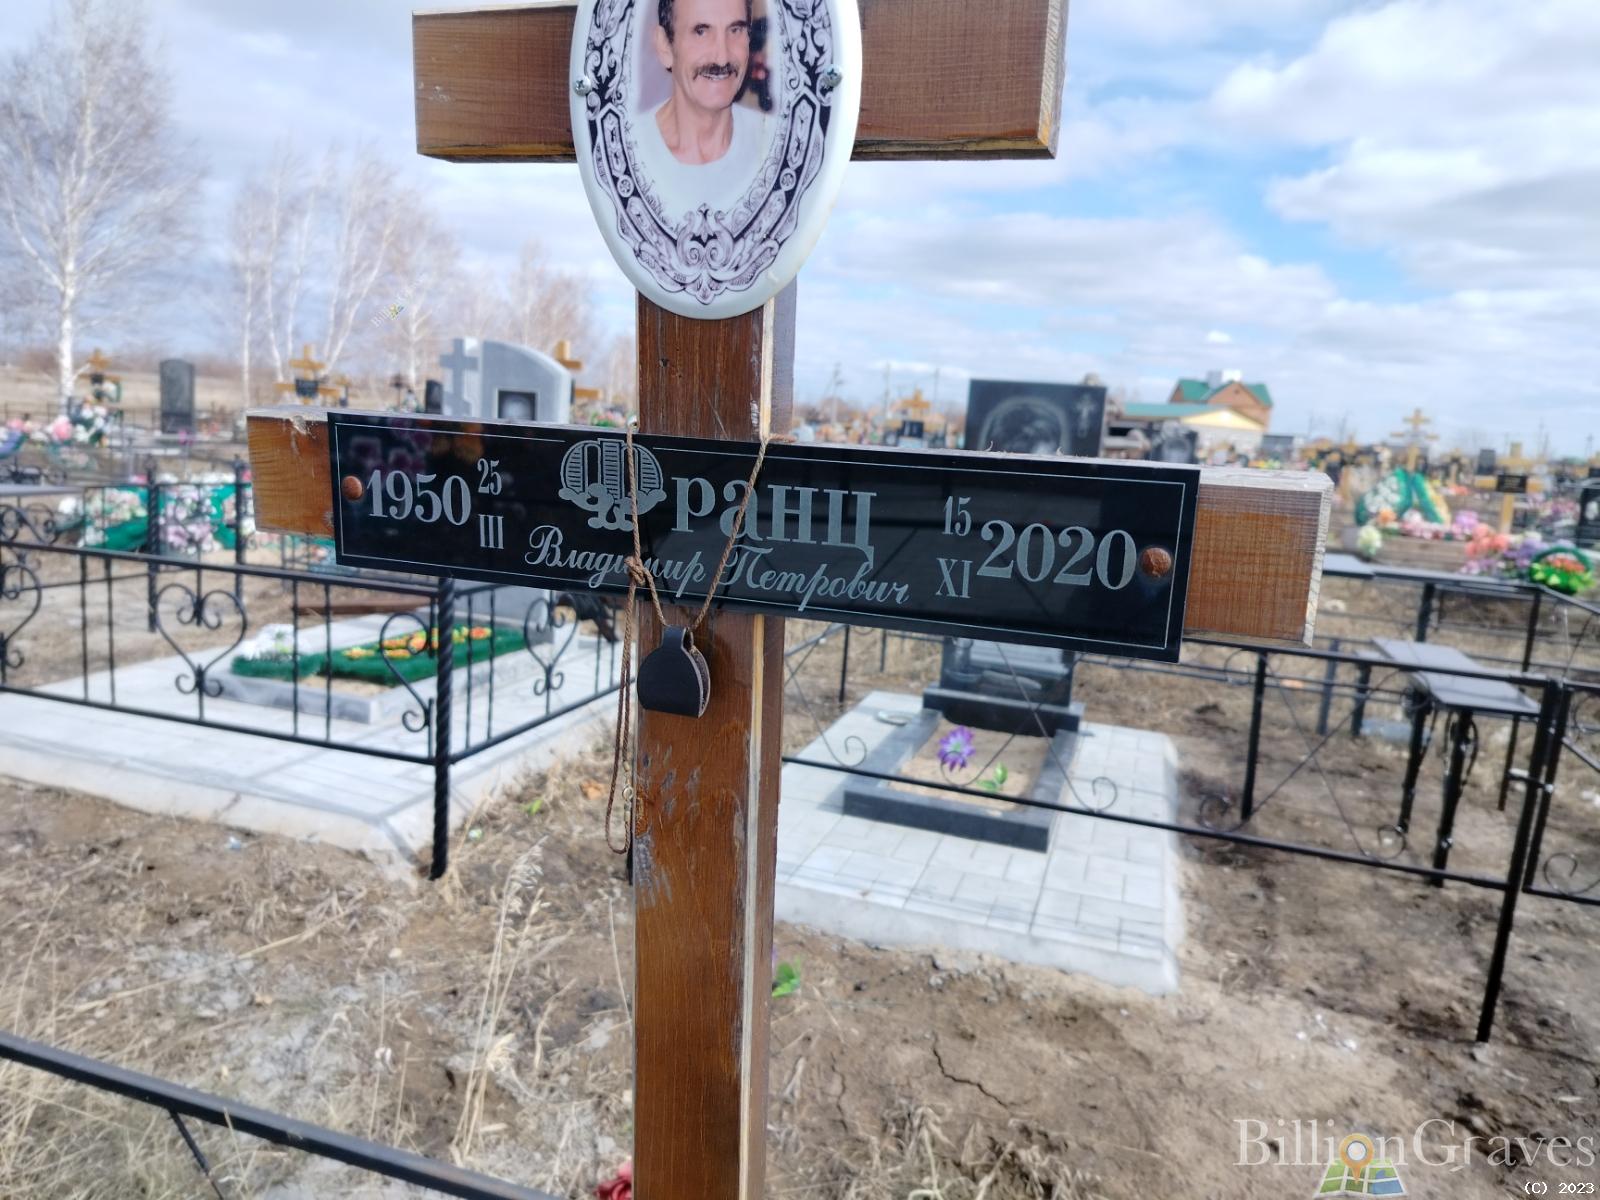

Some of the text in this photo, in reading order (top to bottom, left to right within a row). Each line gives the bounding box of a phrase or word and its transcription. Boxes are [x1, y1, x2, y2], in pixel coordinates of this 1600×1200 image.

[366, 469, 472, 526] 1950
[477, 458, 502, 496] 25
[558, 438, 878, 569] Франц
[942, 495, 972, 537] 15
[478, 513, 505, 550] III
[976, 519, 1137, 590] 2020
[717, 544, 910, 612] Петрович
[935, 557, 974, 599] XI
